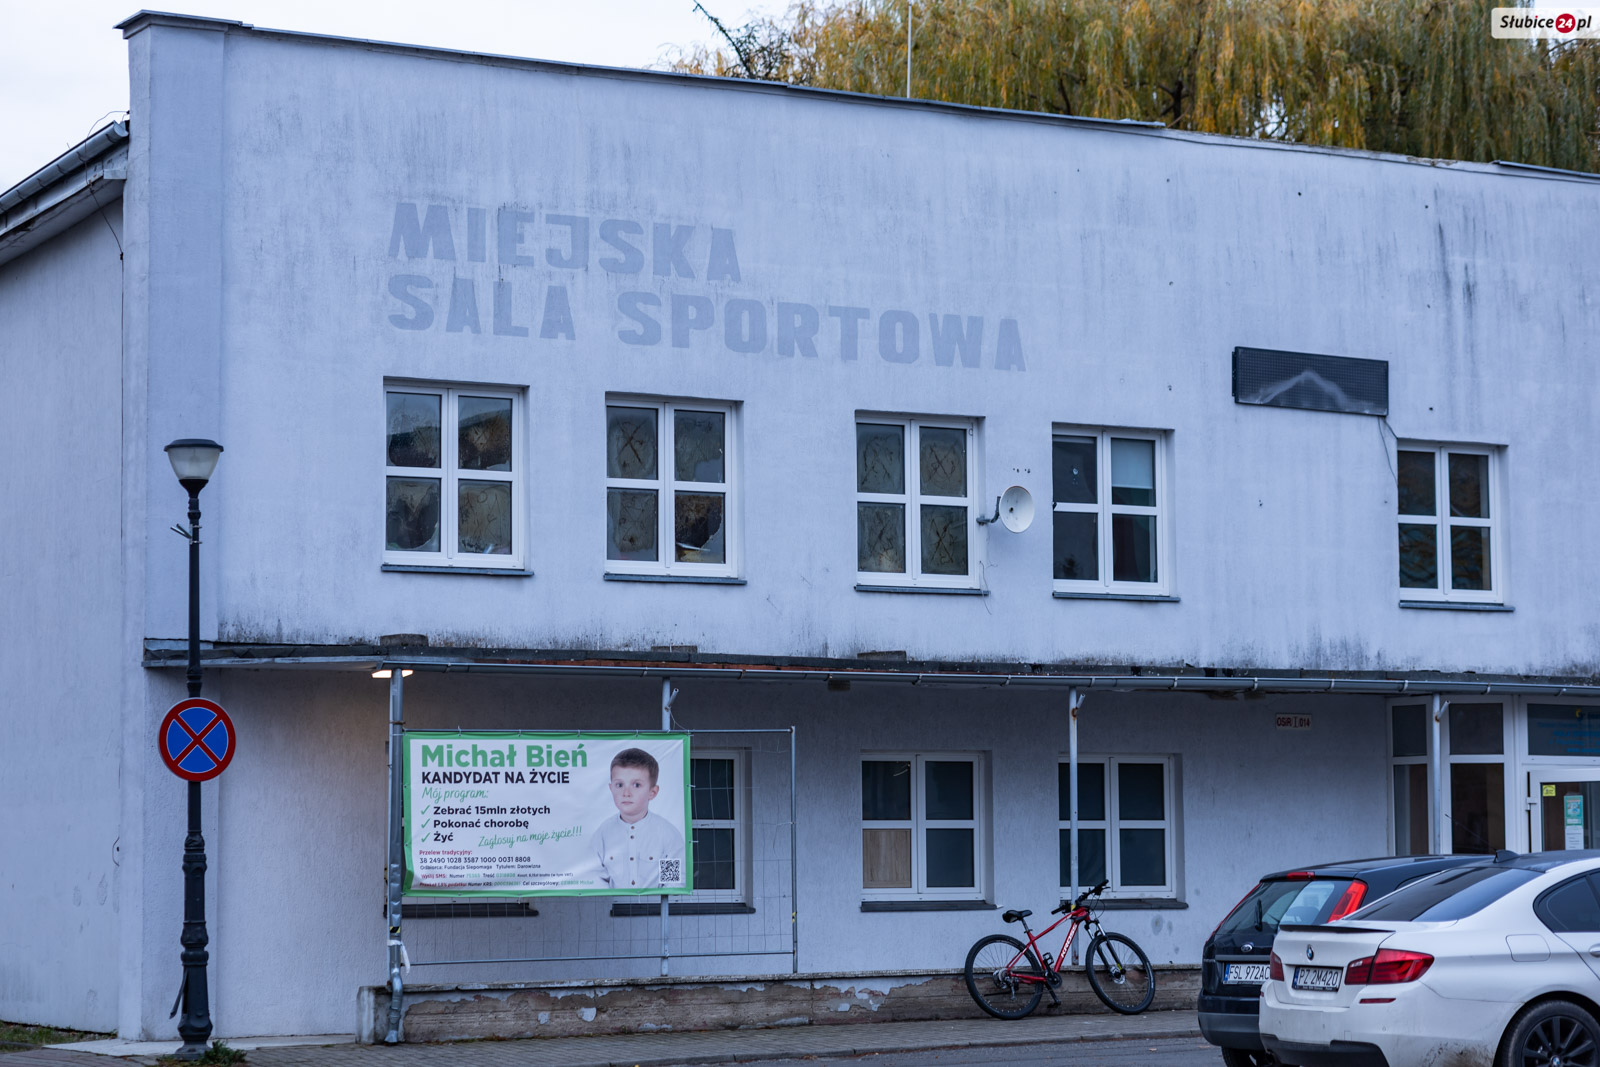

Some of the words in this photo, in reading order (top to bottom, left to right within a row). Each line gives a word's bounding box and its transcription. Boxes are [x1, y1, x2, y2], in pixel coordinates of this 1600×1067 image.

[388, 202, 742, 283] MIEJSKA
[387, 274, 576, 341] SALA
[617, 291, 1027, 372] SPORTOWA
[421, 744, 517, 768] Michał
[526, 743, 588, 768] Bień
[421, 771, 501, 784] KANDYDAT
[504, 771, 526, 784] NA
[529, 768, 570, 784] ŻYCIE
[421, 787, 443, 804] Mój
[443, 789, 489, 803] program:
[433, 805, 472, 815] Zebrać
[475, 805, 507, 815] 15mln
[510, 805, 551, 817] złotych
[433, 818, 481, 829] Pokonać
[484, 818, 530, 830] chorobę
[433, 831, 454, 843] Żyć
[478, 836, 515, 849] Zagłosuj
[516, 834, 529, 843] na
[529, 831, 550, 845] moje
[550, 825, 583, 840] życie!!!
[441, 849, 473, 857] tradycyjny:
[1060, 922, 1078, 958] KROSS
[1228, 965, 1243, 980] FSL
[1299, 968, 1311, 984] PZ
